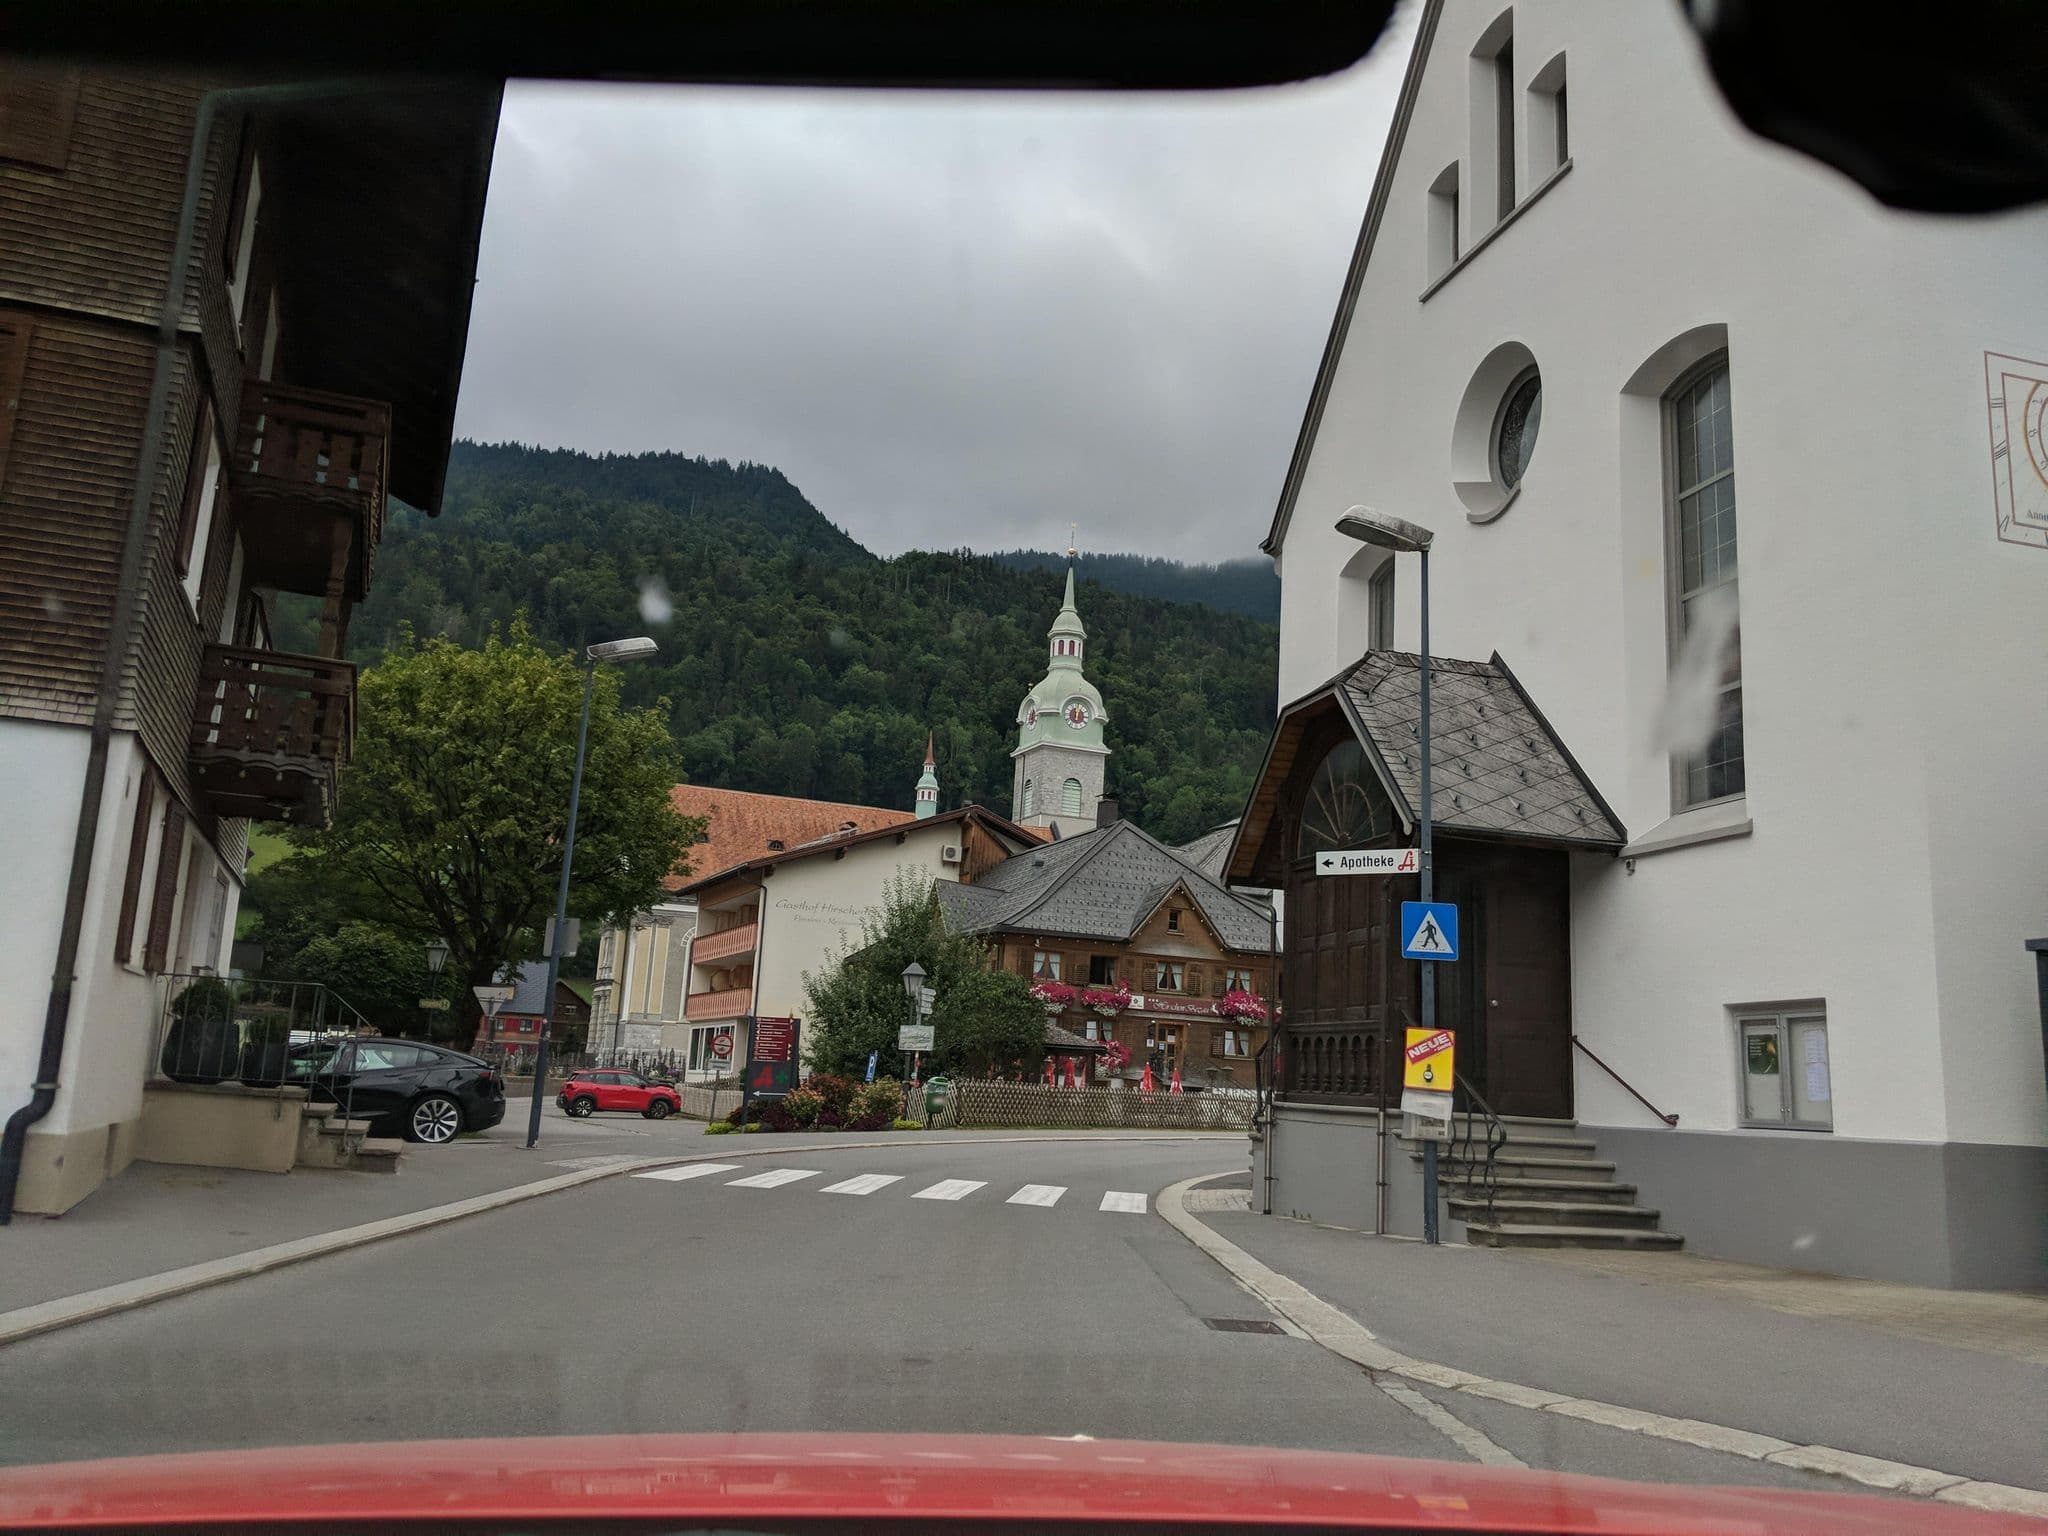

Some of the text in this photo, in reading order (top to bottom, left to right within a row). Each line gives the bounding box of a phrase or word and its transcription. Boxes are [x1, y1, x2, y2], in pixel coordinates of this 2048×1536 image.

[1340, 855, 1394, 871] Apotheke
[775, 898, 819, 913] Gasthof
[1408, 1033, 1450, 1058] NEUE
